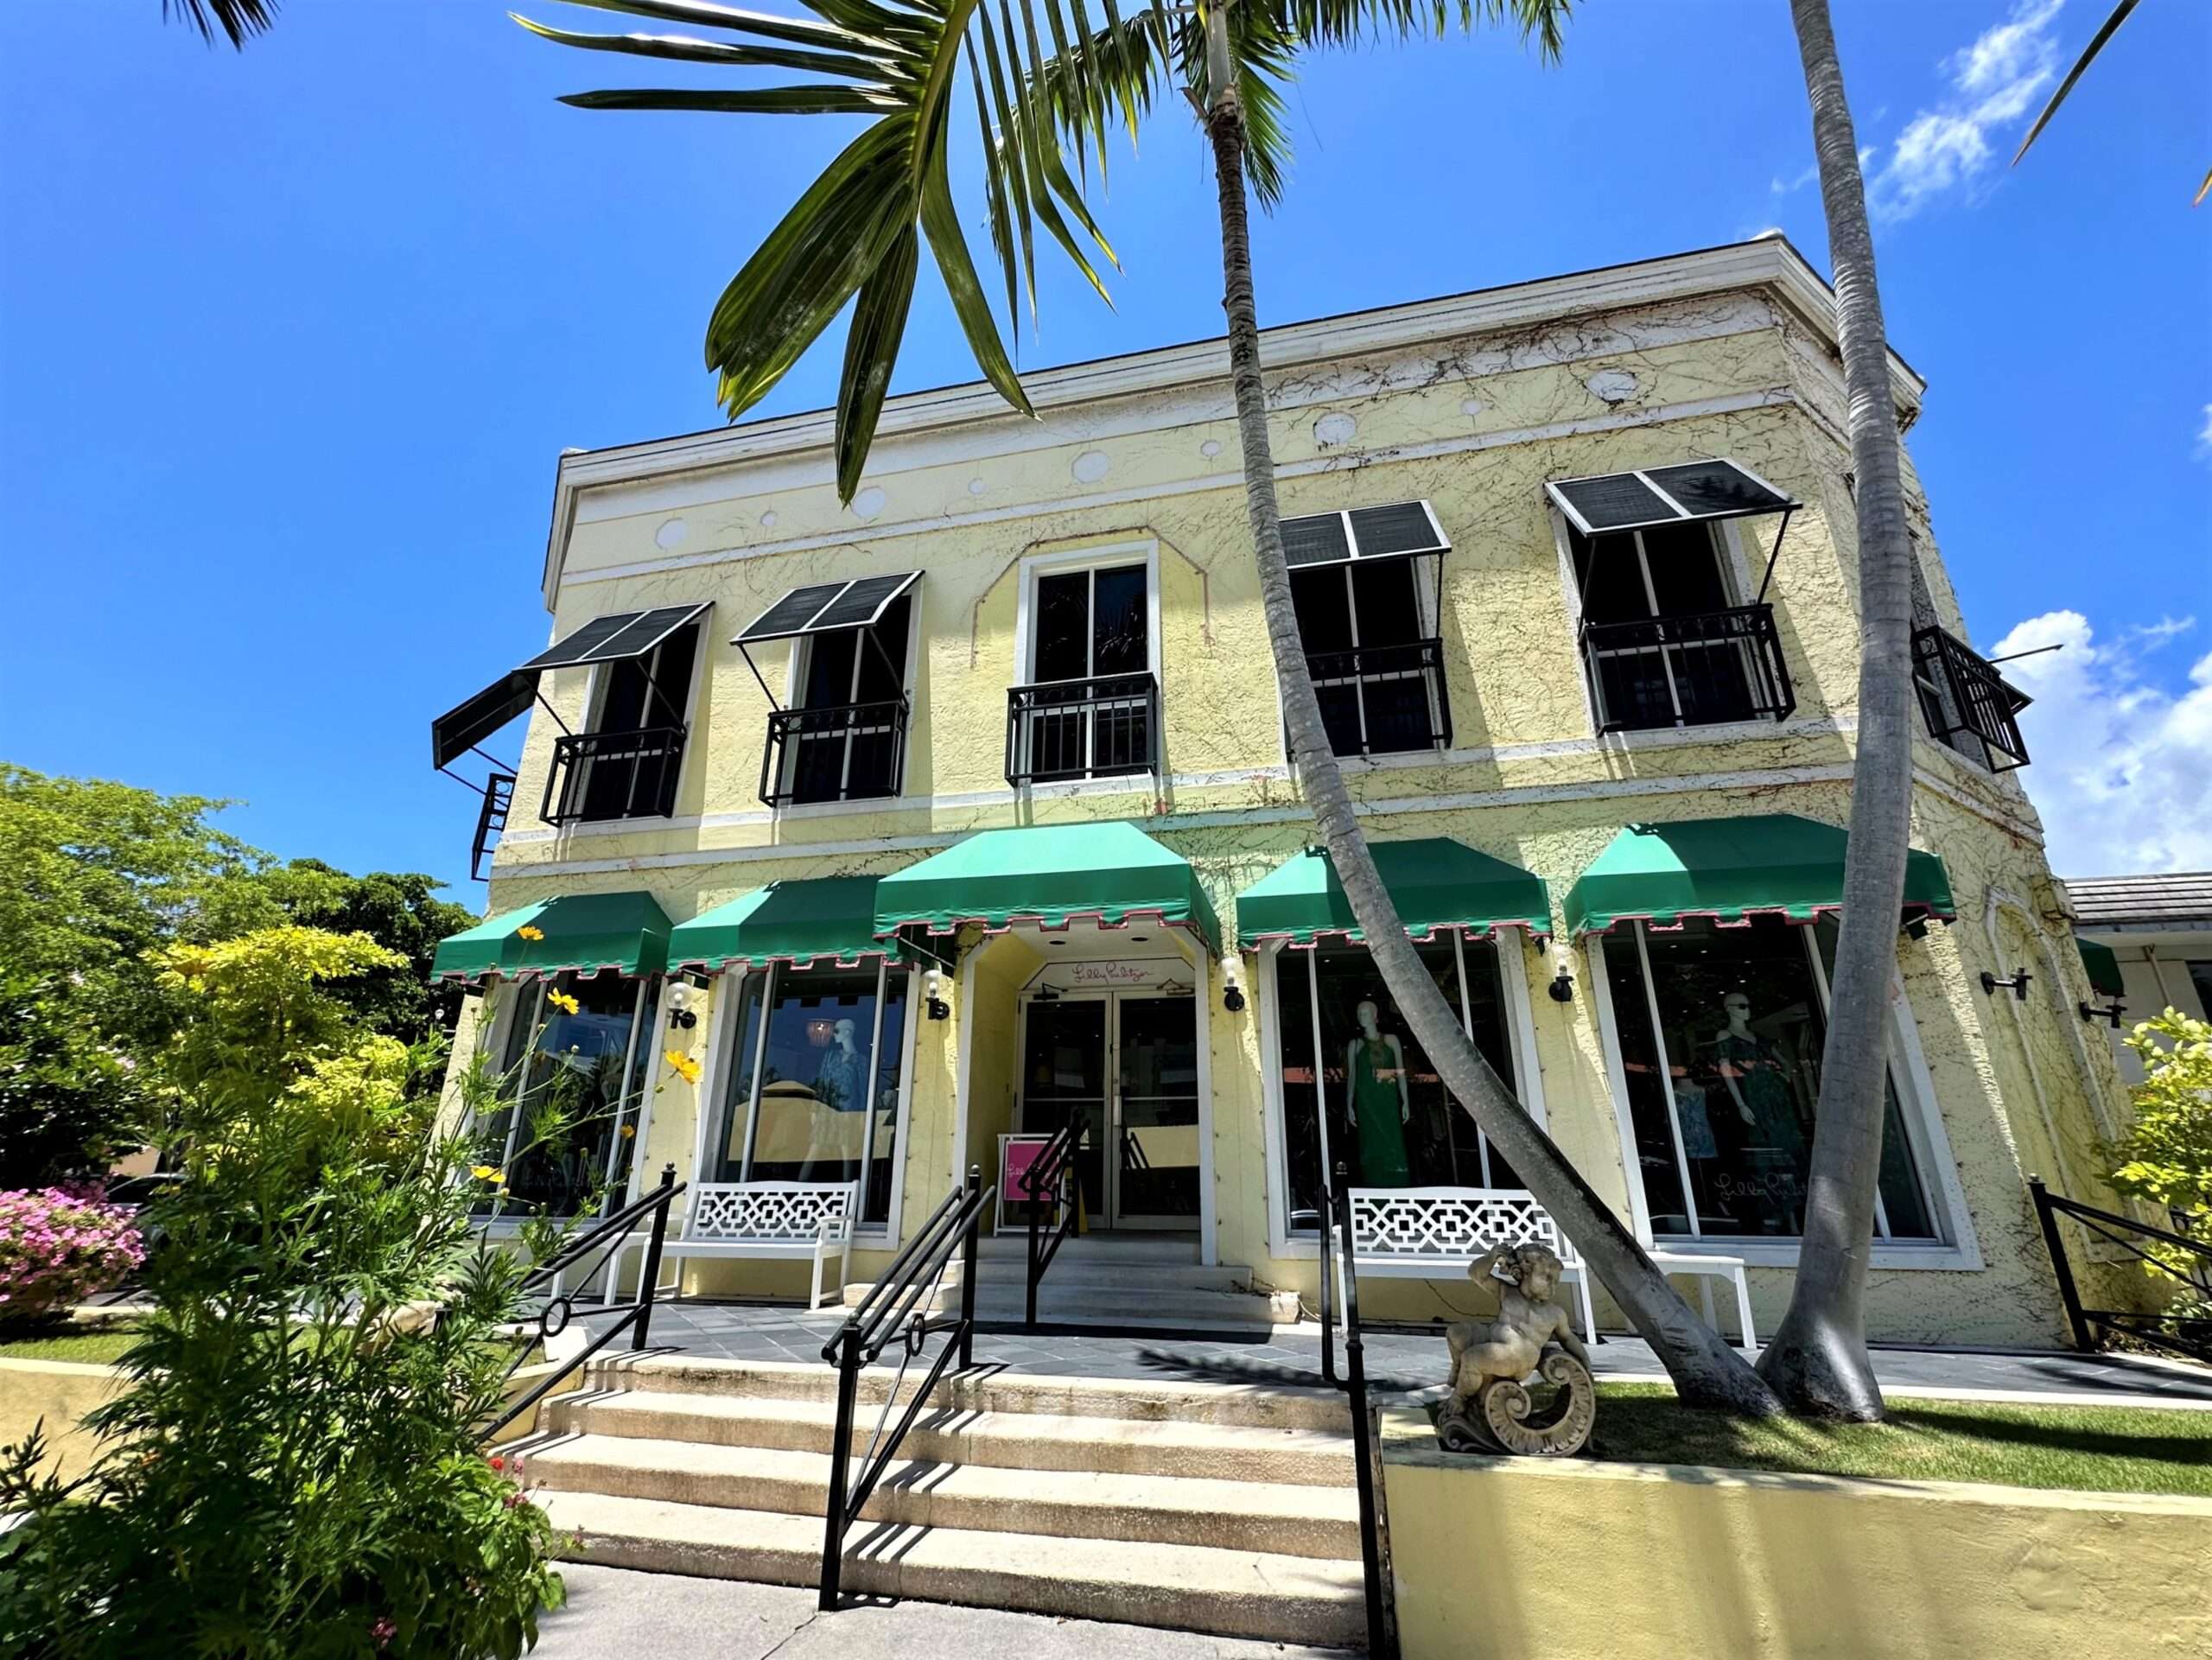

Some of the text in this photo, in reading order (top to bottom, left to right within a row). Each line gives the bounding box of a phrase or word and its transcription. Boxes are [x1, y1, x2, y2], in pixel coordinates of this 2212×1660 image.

[1071, 961, 1154, 985] Lilly Pulitzer
[1714, 1173, 1774, 1205] Lilly
